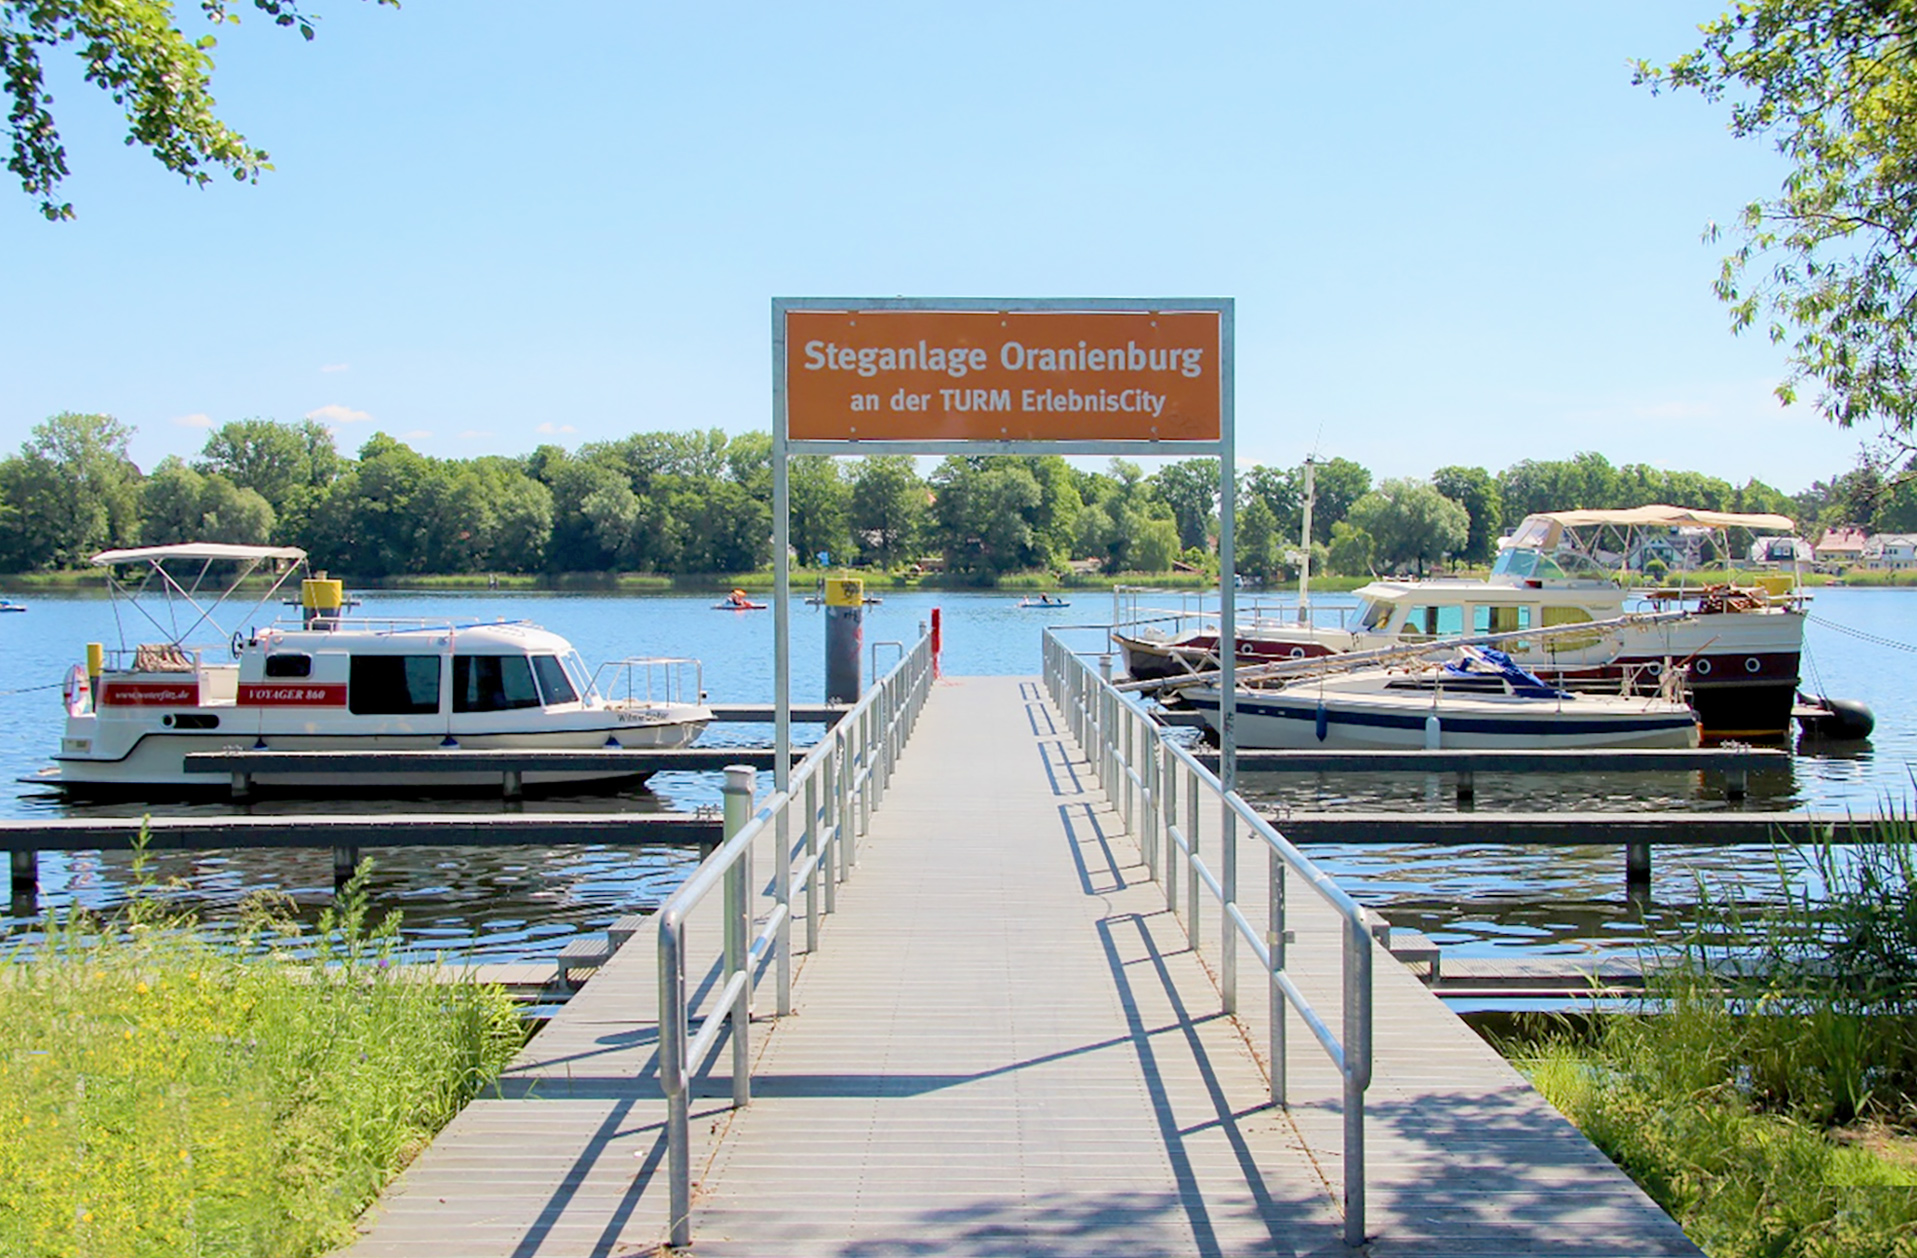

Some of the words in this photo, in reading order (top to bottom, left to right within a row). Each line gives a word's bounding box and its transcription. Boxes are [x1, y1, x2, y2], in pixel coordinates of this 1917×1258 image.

[804, 339, 987, 377] Steganlage
[1000, 340, 1204, 378] Oranienburg
[850, 393, 880, 412] an
[890, 387, 932, 412] der
[939, 388, 1012, 412] TURM
[1021, 388, 1167, 418] ErlebnisCity
[249, 689, 304, 699] VOYAGER
[305, 689, 326, 699] 860
